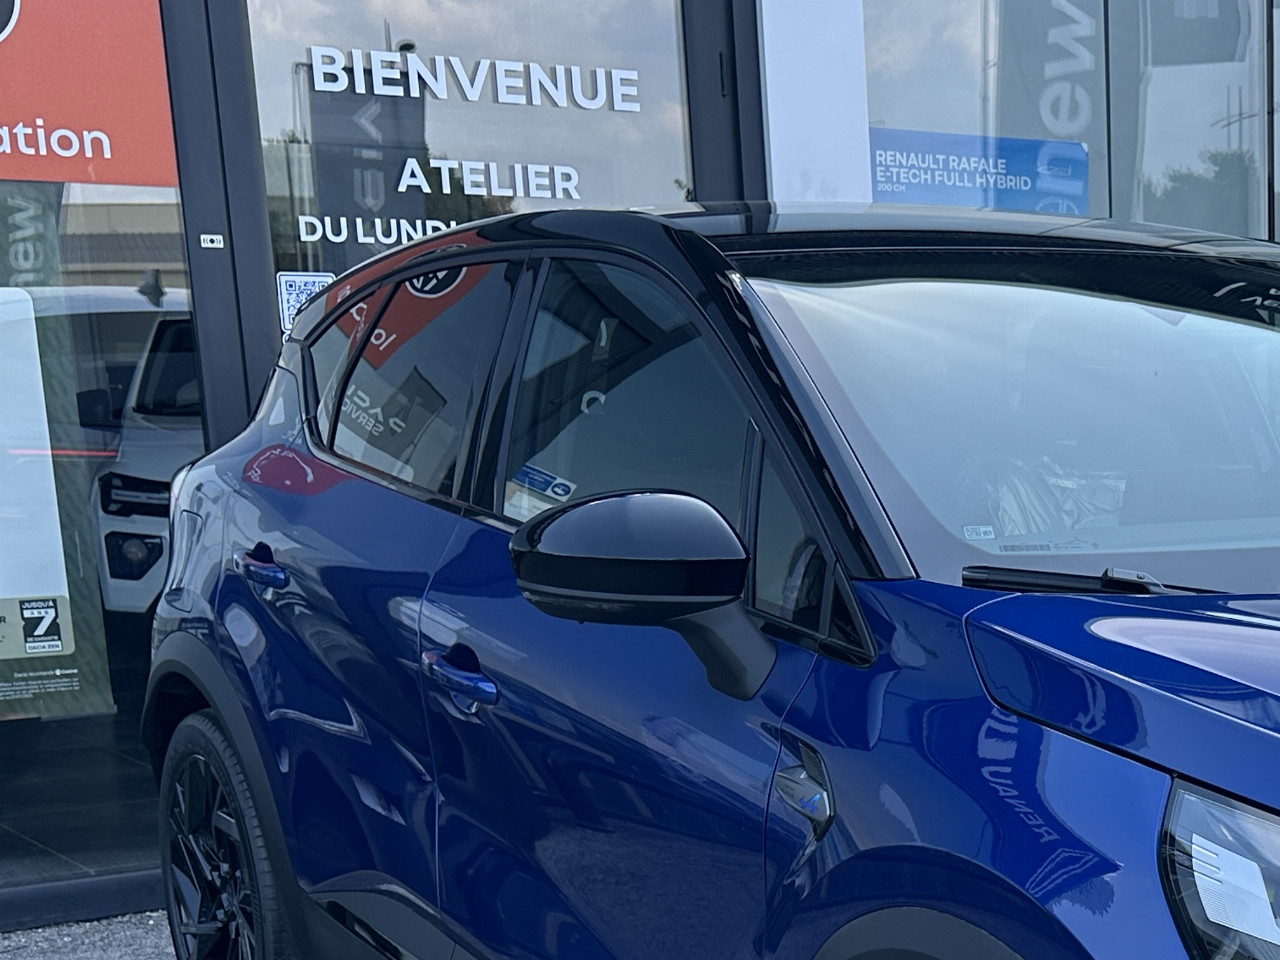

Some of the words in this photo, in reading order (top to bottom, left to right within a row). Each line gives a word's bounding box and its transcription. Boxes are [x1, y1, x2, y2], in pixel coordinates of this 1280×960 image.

[310, 45, 641, 112] BIENVENUE
[876, 150, 946, 169] RENAULT
[949, 155, 1006, 174] RAFALE
[397, 157, 581, 200] ATELIER
[876, 167, 932, 185] E-TECH
[935, 170, 972, 187] FULL
[976, 174, 1031, 191] HYBRID
[877, 183, 893, 192] 200
[893, 184, 906, 192] CH
[298, 215, 348, 243] DU
[356, 217, 457, 245] LUND
[23, 608, 56, 636] 7
